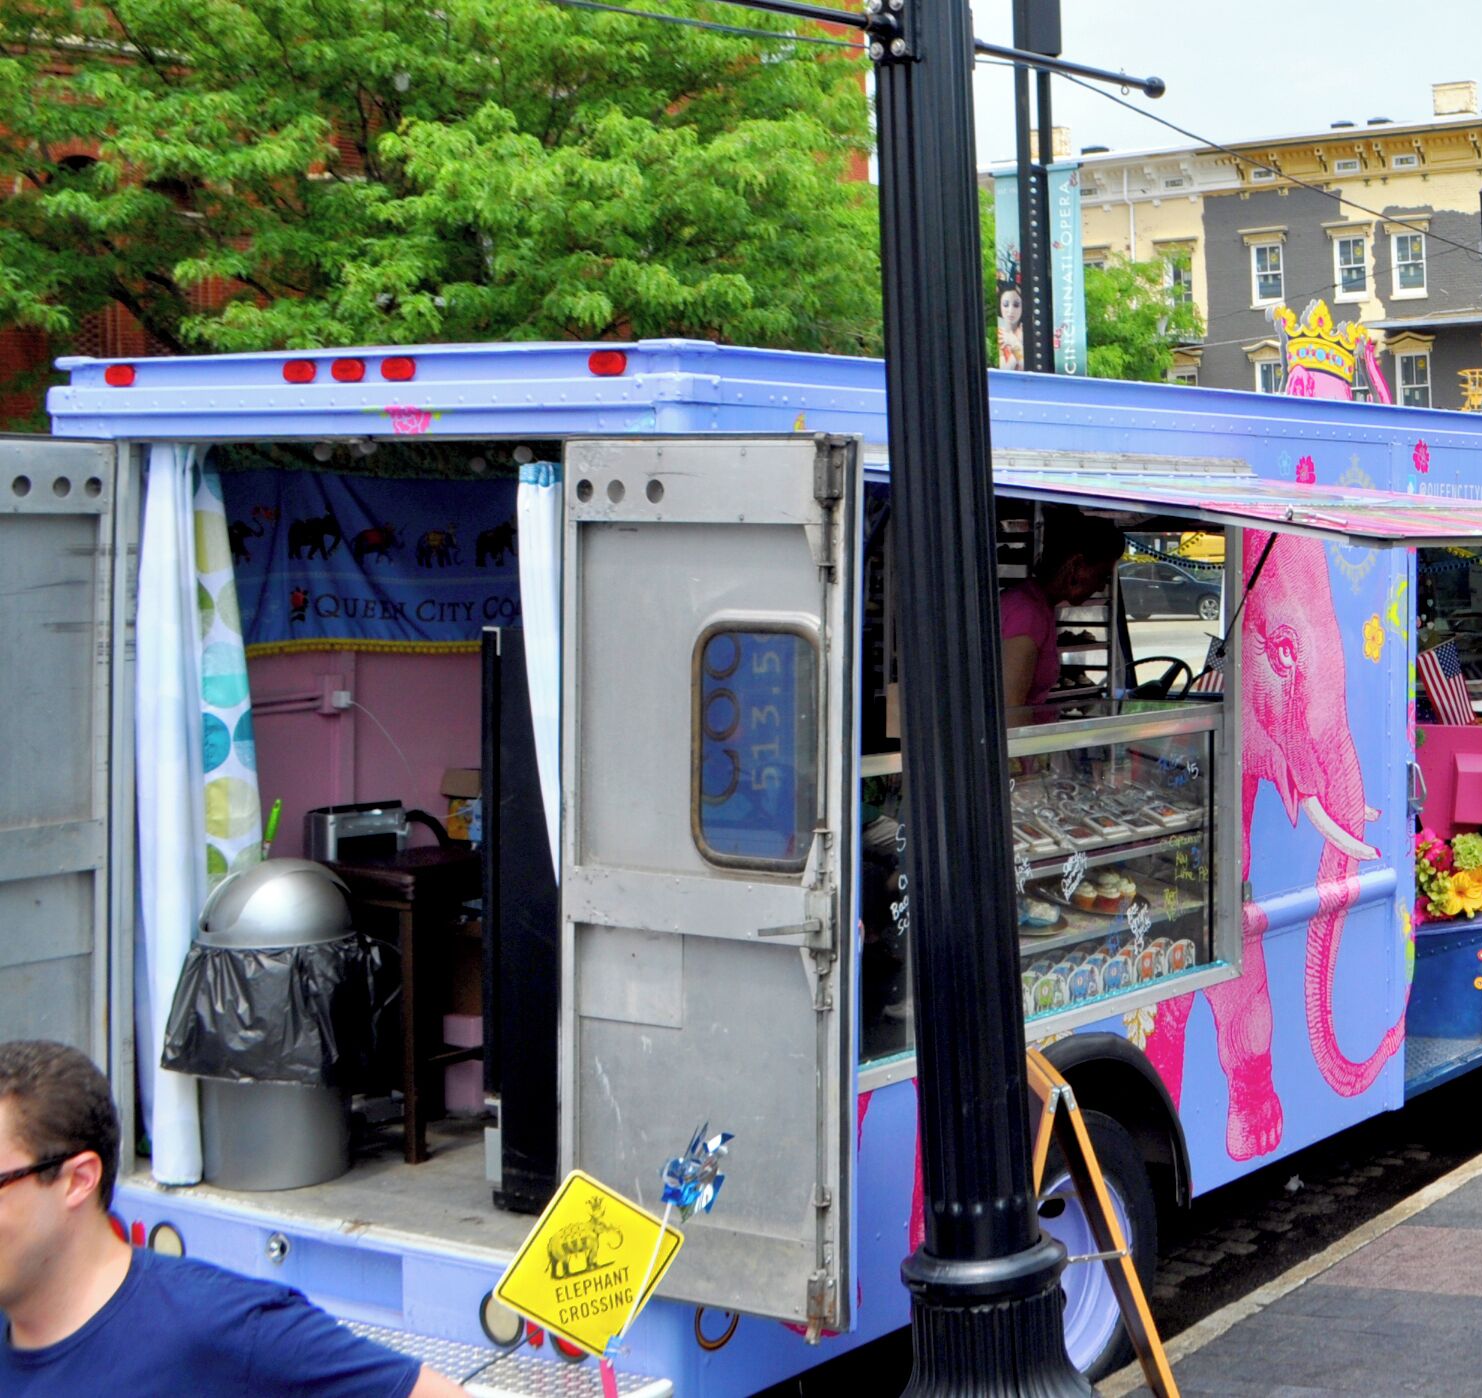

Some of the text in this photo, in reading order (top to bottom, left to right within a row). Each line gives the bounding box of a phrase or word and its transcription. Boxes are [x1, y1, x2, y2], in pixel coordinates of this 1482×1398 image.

[1059, 182, 1074, 246] OPERA
[314, 592, 405, 621] QUEEN
[416, 599, 473, 622] CITY
[752, 633, 782, 791] 513.5
[555, 1266, 629, 1304] ELEPHANT
[559, 1287, 634, 1325] CROSSING
